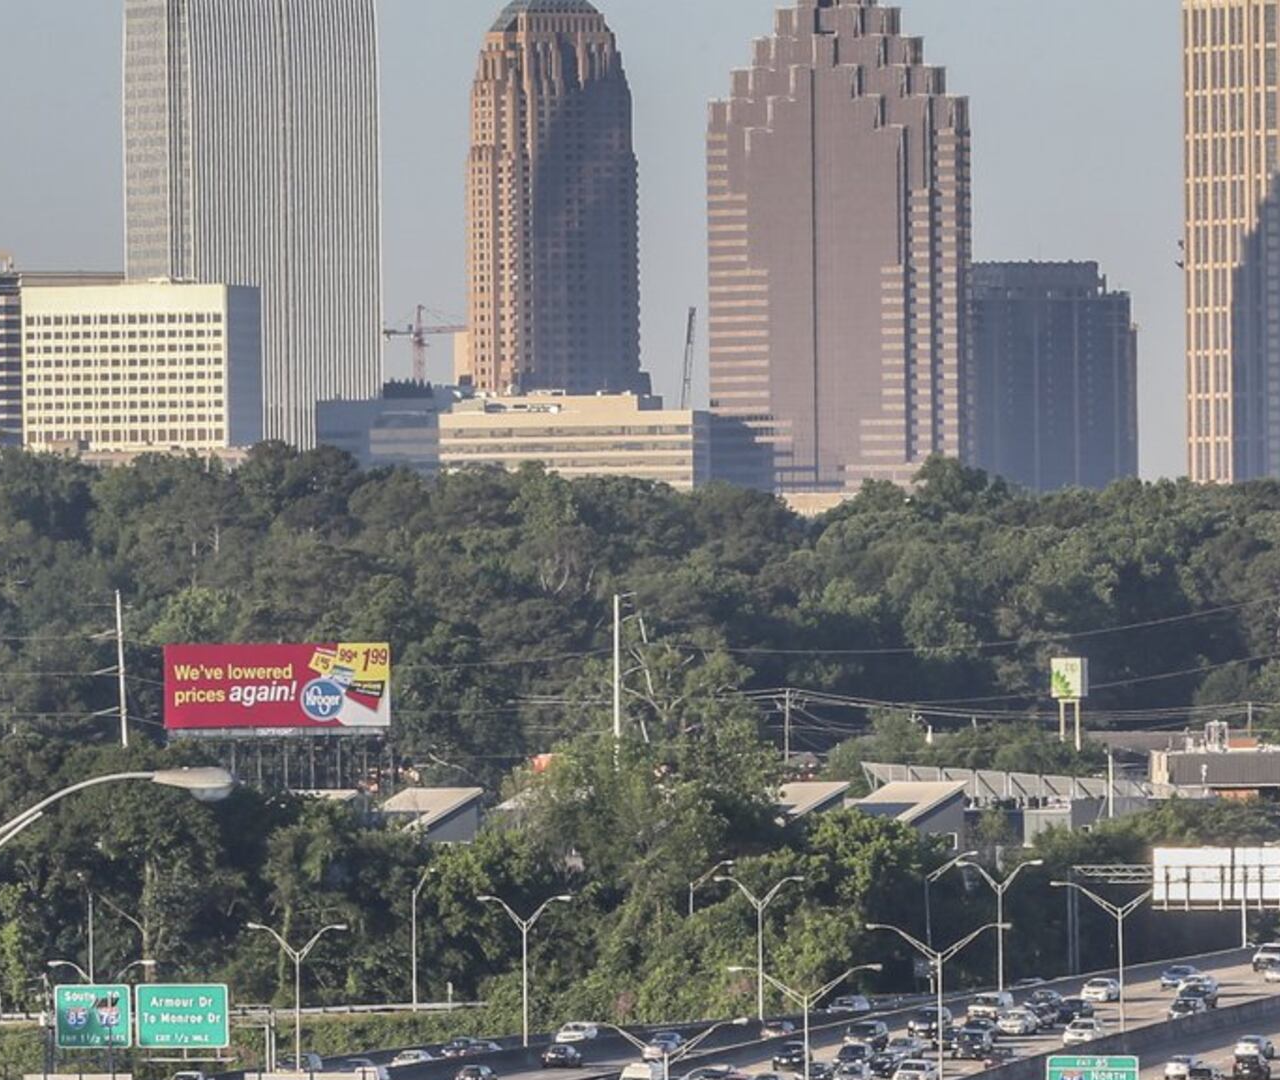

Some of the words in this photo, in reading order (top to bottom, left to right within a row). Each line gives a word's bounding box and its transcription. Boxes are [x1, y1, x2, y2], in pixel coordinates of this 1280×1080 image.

[174, 664, 223, 680] We've
[228, 663, 293, 680] lowered
[174, 687, 225, 706] prices
[229, 681, 298, 707] again!
[305, 685, 341, 715] Kroger
[150, 996, 194, 1008] Armour
[199, 996, 213, 1008] Dr
[67, 1011, 87, 1025] 85
[143, 1012, 156, 1024] To
[160, 1012, 203, 1024] Monroe
[207, 1012, 221, 1024] Dr
